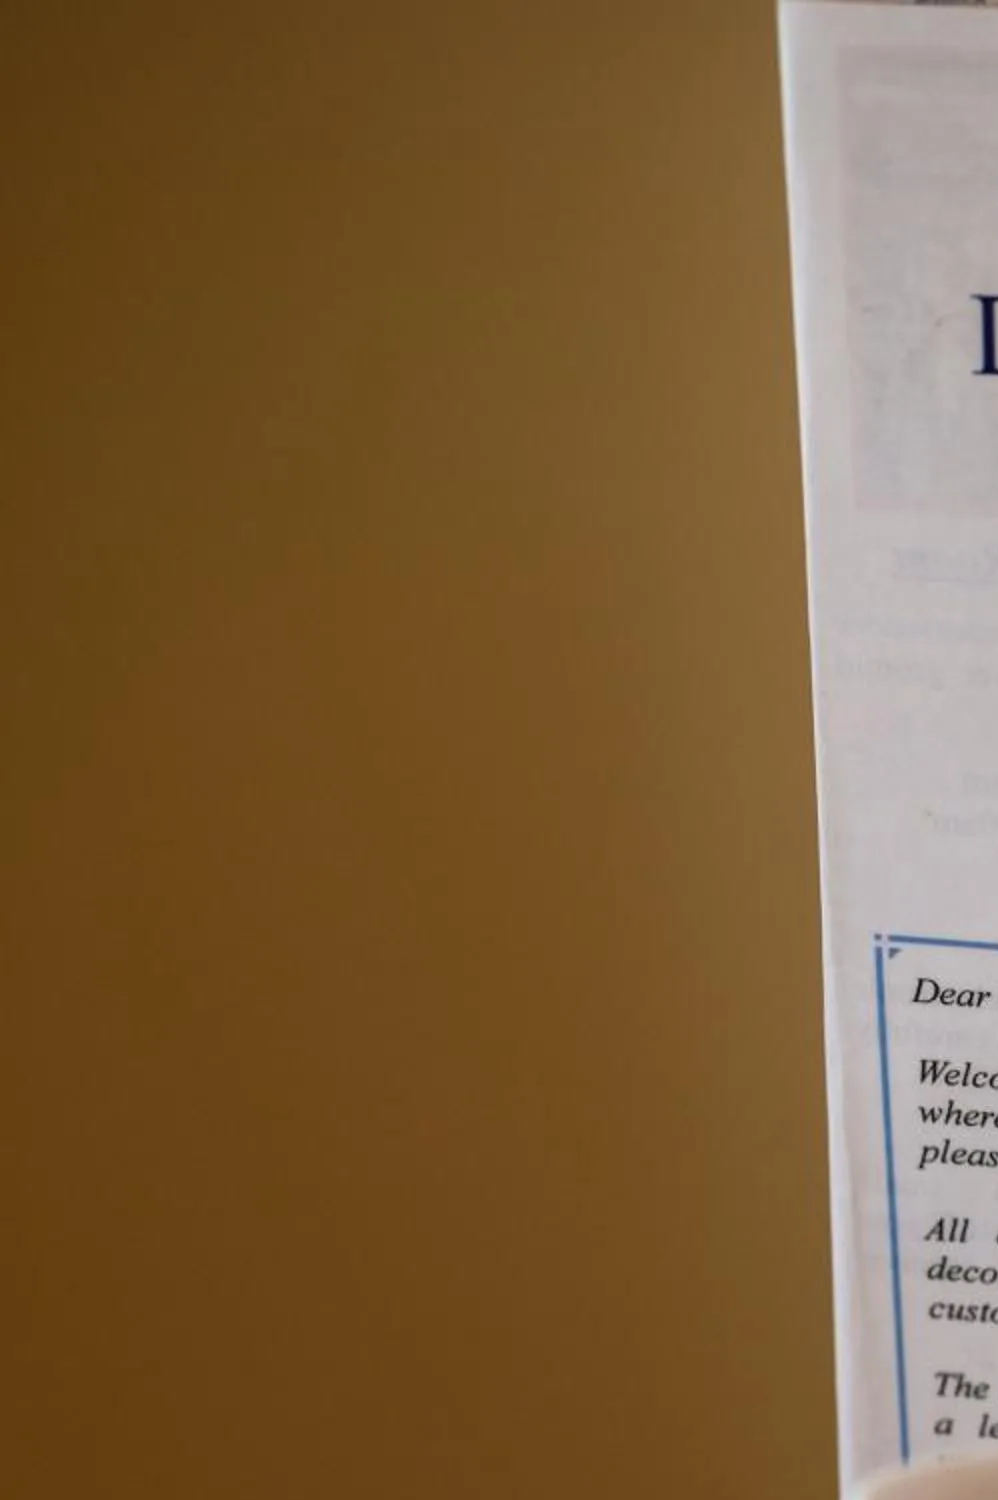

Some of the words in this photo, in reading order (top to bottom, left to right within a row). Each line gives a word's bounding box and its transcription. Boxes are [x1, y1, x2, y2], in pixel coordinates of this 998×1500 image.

[912, 977, 991, 1008] Dear
[924, 1217, 970, 1244] All
[934, 1372, 990, 1401] The
[934, 1416, 953, 1436] a
